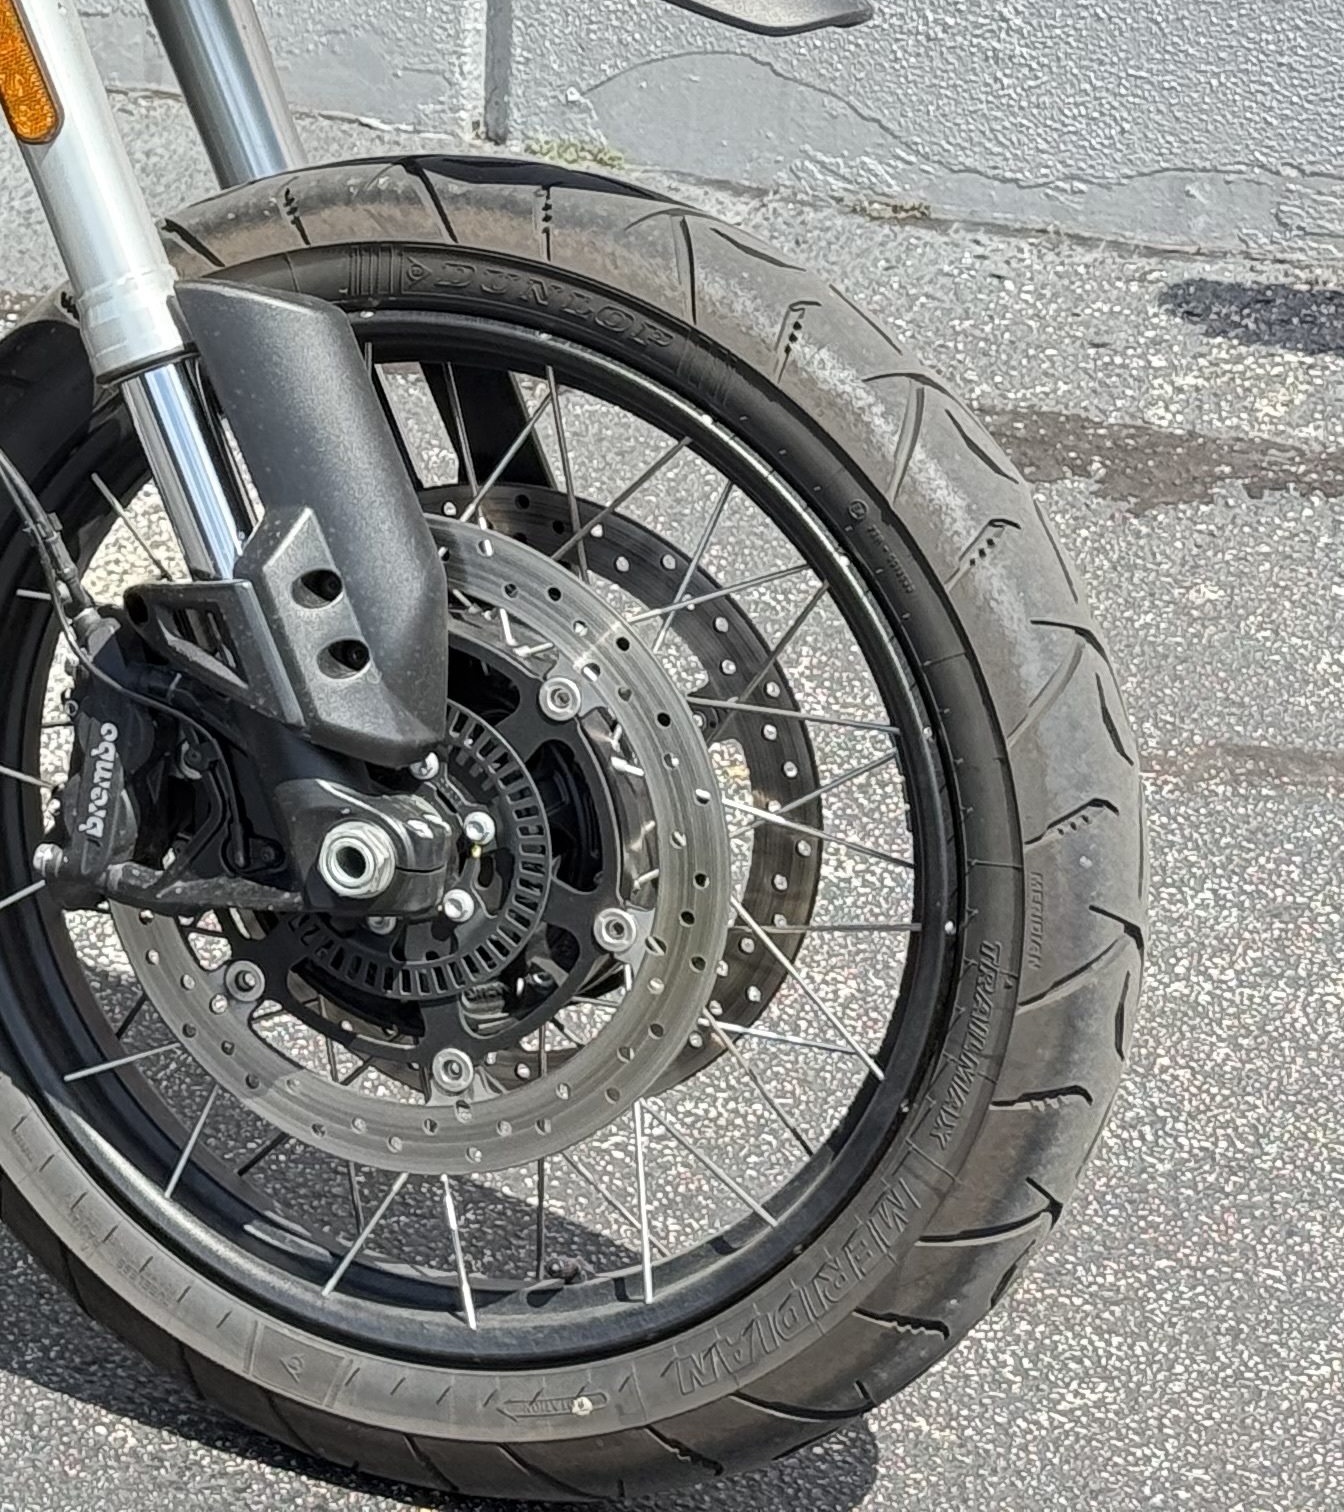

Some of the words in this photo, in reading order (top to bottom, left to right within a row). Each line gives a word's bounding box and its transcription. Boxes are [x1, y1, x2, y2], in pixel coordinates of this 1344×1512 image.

[436, 262, 673, 347] DUNLOP
[78, 722, 119, 838] brembo
[1026, 870, 1046, 971] MERIDIAN
[934, 940, 1001, 1145] TRAILMAX
[672, 1177, 921, 1395] MERIDIAN
